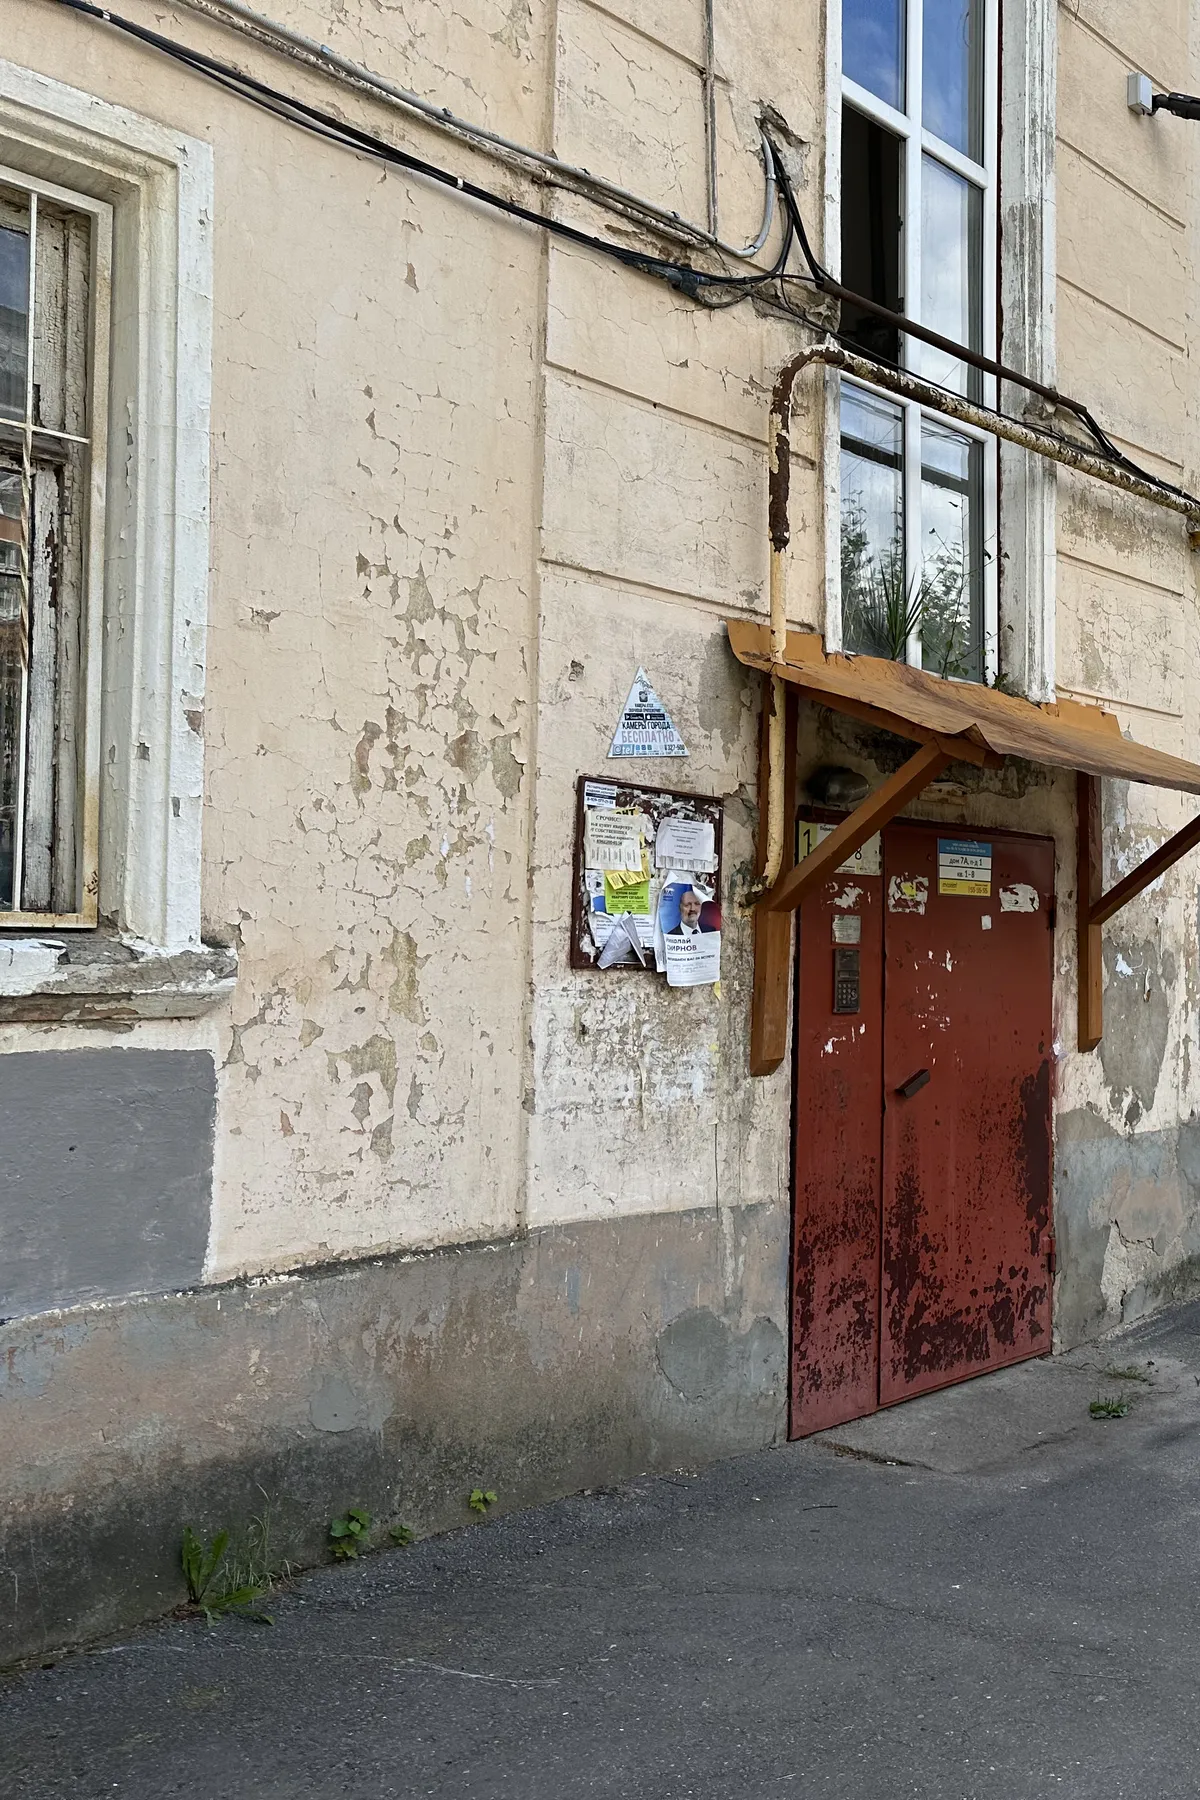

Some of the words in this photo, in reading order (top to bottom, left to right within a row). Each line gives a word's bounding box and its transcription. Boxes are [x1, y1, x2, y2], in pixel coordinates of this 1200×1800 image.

[621, 721, 646, 730] КАМЕРЫ
[647, 722, 671, 730] ГОРОДА
[621, 730, 674, 743] БЕСПЛАТНО
